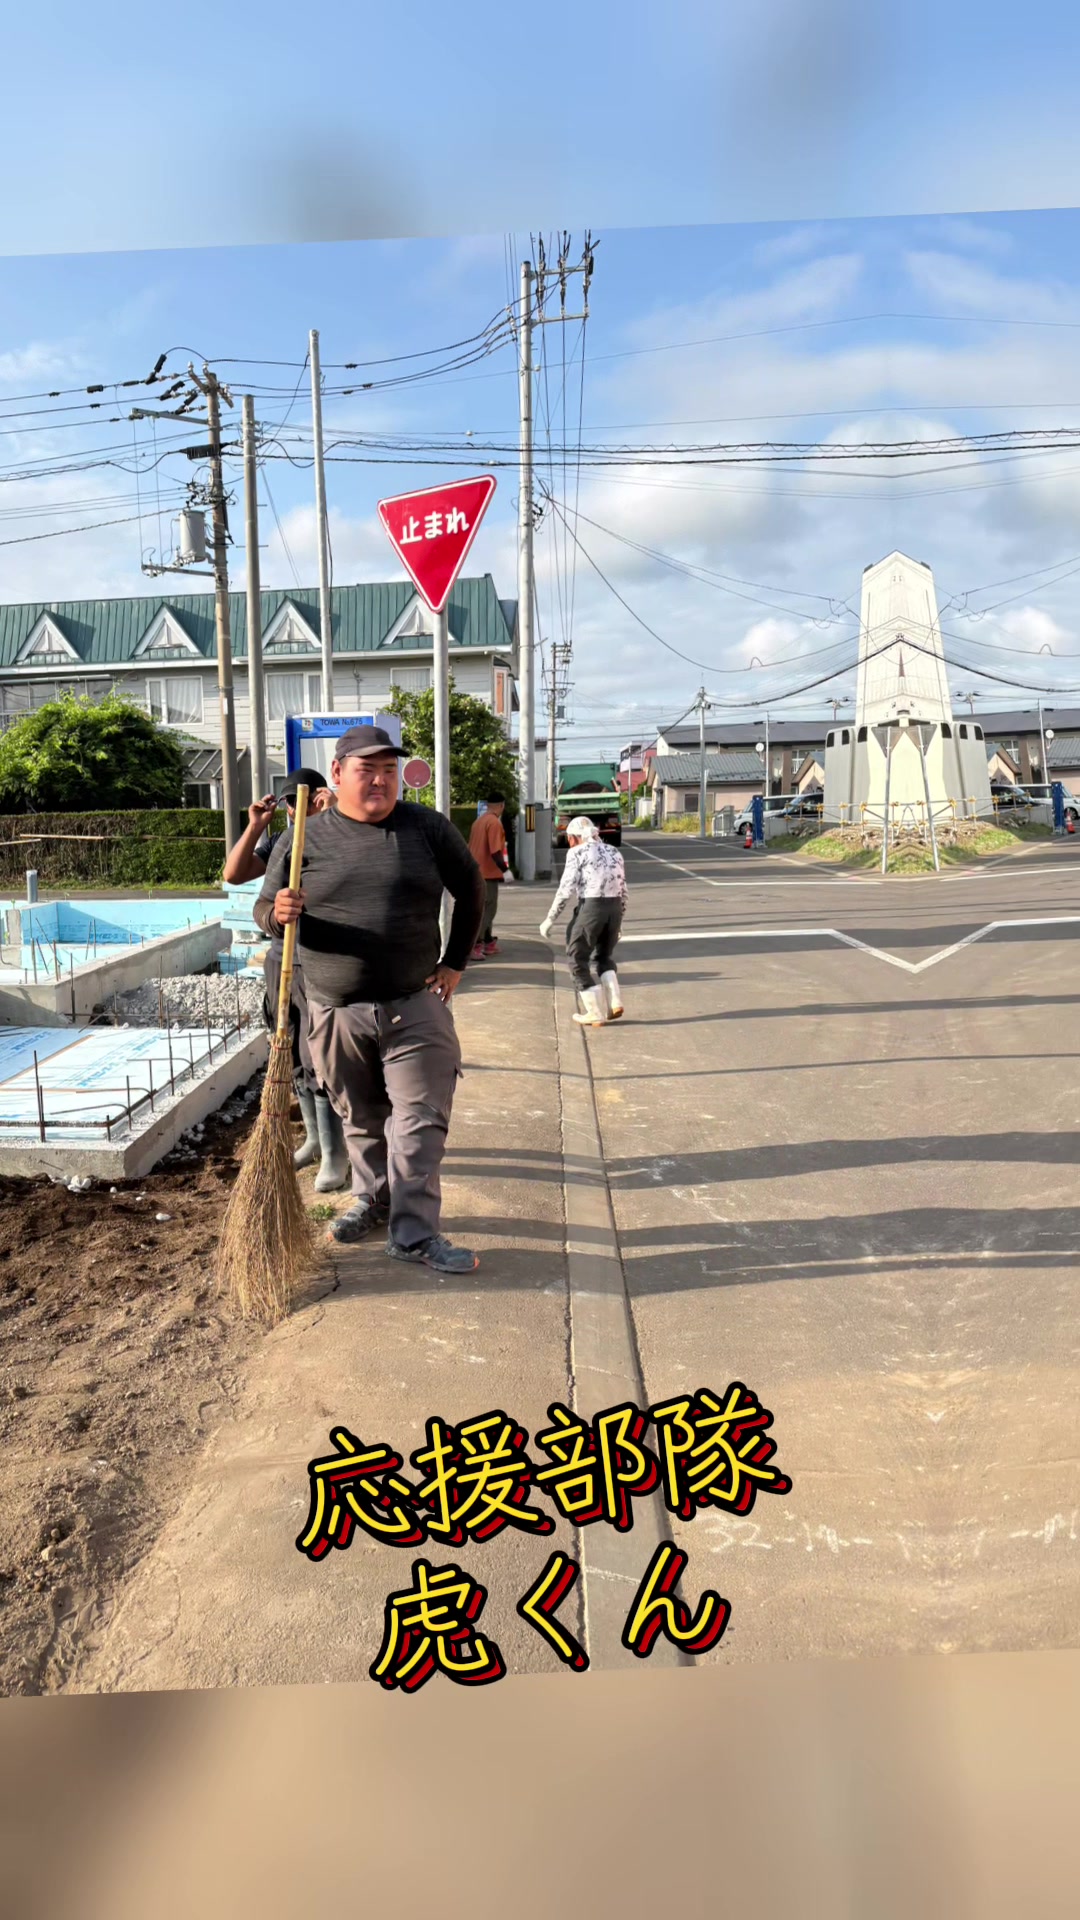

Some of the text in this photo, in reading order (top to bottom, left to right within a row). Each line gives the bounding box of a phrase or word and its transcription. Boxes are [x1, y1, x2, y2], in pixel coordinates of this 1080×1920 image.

[400, 507, 470, 544] 止まれ
[320, 718, 340, 726] TOWA
